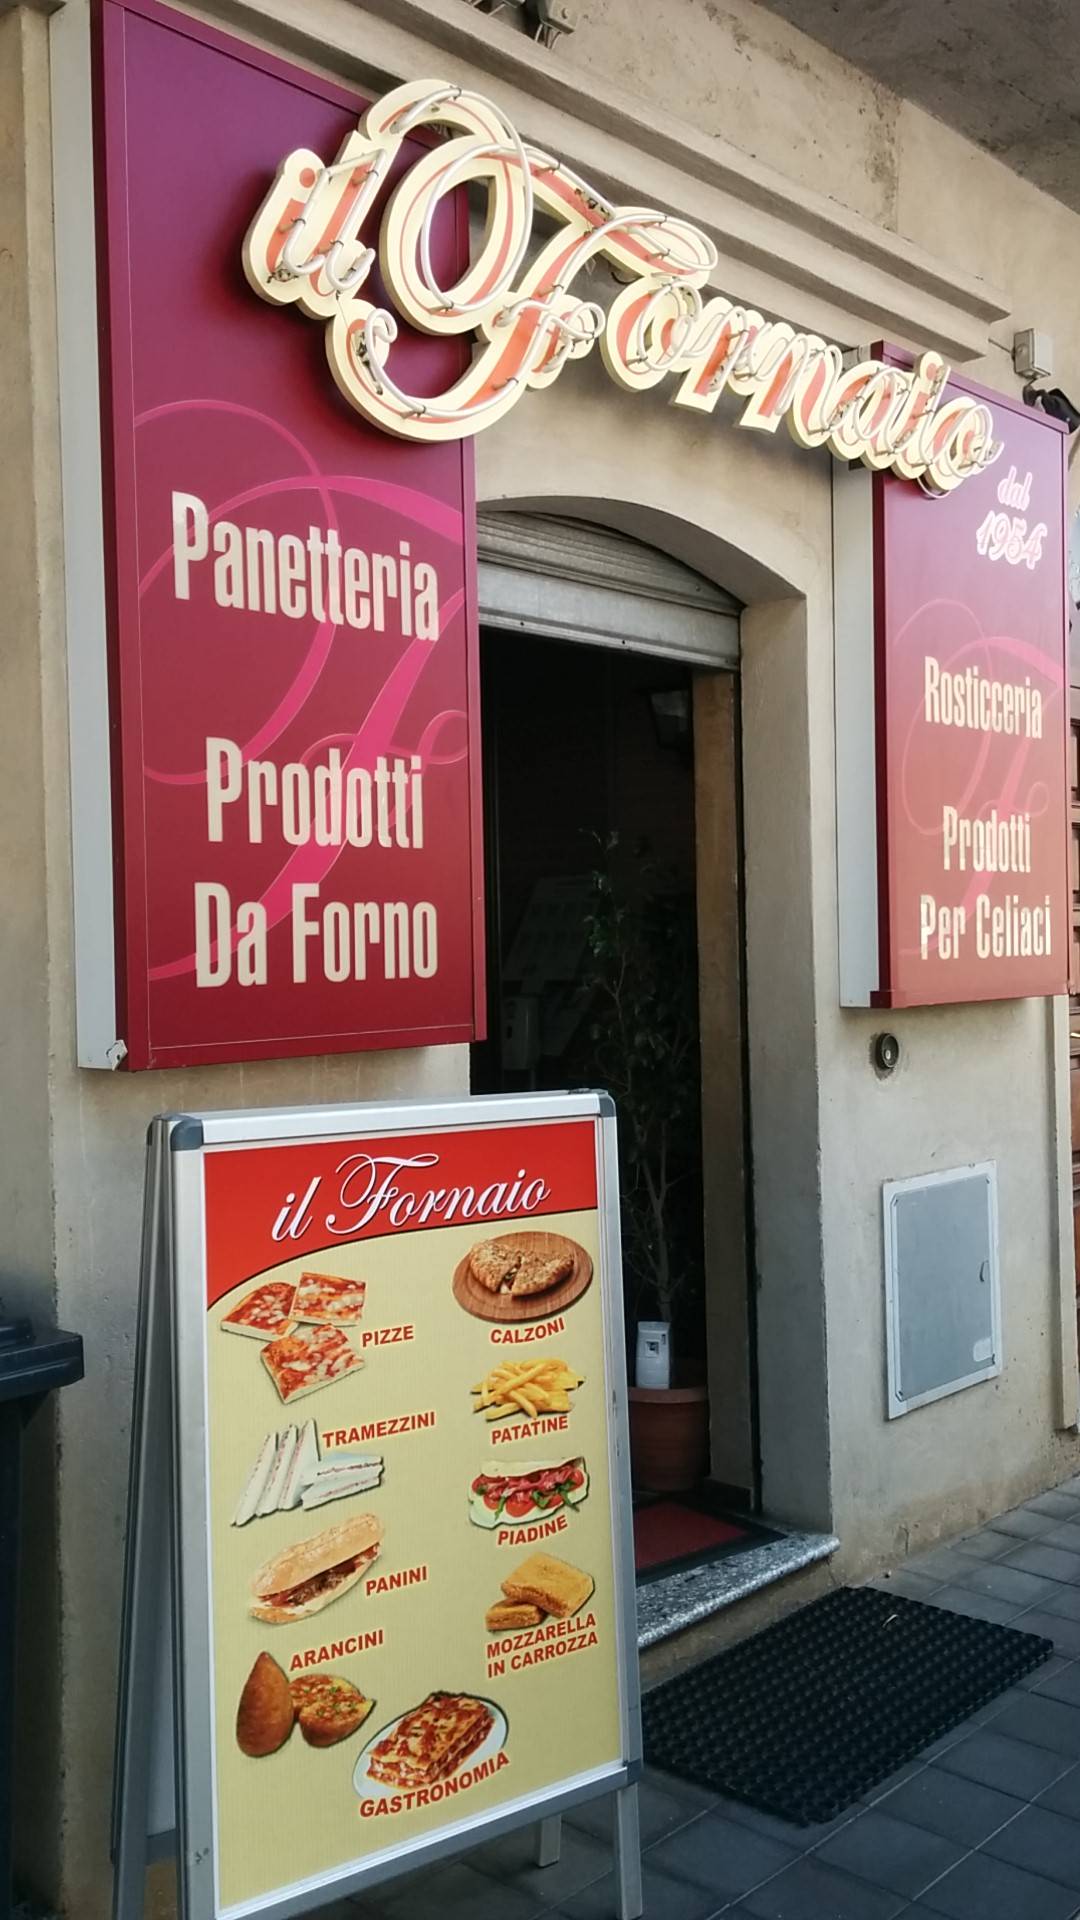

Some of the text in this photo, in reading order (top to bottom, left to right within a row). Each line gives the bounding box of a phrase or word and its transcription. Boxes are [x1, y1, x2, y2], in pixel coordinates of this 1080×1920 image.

[322, 78, 1003, 498] Fornaio
[997, 466, 1031, 512] dal
[171, 490, 440, 642] Panetteria
[924, 656, 1043, 740] Rosticceria
[205, 736, 424, 850] Prodotti
[943, 805, 1032, 874] Prodotti
[194, 882, 439, 988] Da Forno
[920, 895, 1052, 961] Per Celiaci
[271, 1153, 551, 1241] il Fornaio
[361, 1325, 415, 1348] PIZZE
[490, 1317, 566, 1346] CALZONI
[322, 1411, 436, 1449] TRAMEZZINI
[491, 1416, 570, 1446] PATATINE
[497, 1515, 569, 1546] PIADINE
[365, 1566, 429, 1597] PANINI
[289, 1629, 385, 1671] ARANCINI
[486, 1613, 597, 1660] MOZZARELLA
[487, 1631, 599, 1679] IN CARROZZA
[359, 1752, 510, 1819] GASTRONOMIA
